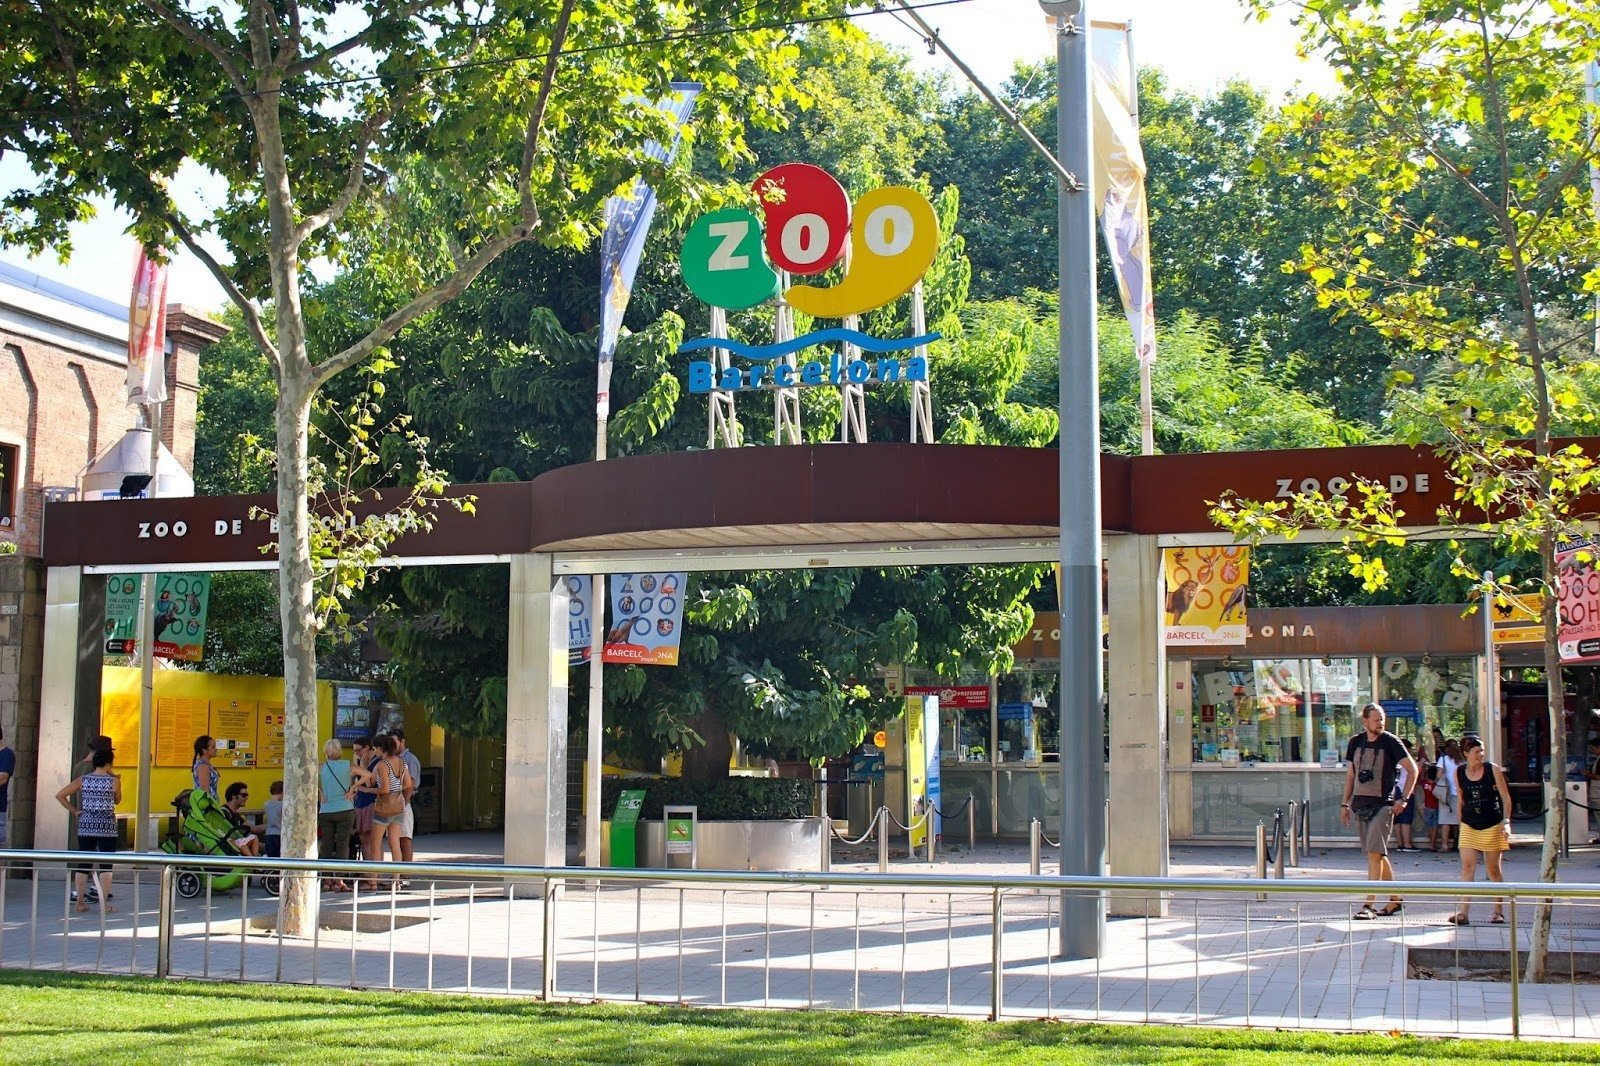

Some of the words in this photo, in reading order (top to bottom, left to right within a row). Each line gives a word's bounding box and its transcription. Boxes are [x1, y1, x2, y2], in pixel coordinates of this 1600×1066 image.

[689, 353, 928, 393] Barcelona
[1276, 475, 1349, 498] ZOO
[1390, 473, 1429, 494] DE
[138, 520, 187, 539] ZOO
[214, 519, 242, 536] DE
